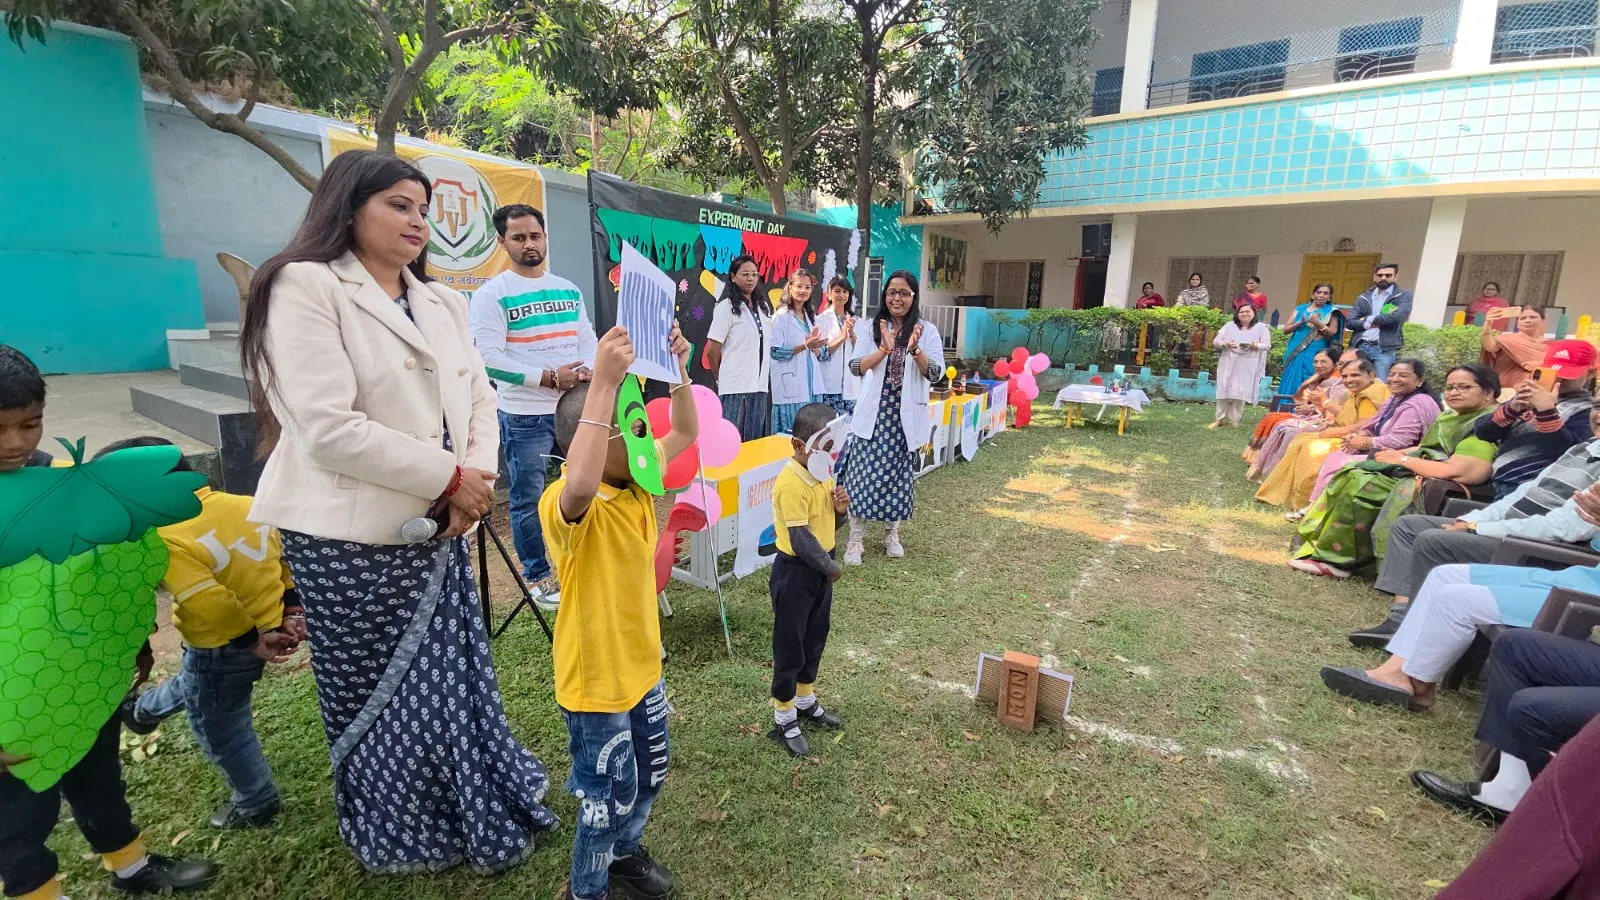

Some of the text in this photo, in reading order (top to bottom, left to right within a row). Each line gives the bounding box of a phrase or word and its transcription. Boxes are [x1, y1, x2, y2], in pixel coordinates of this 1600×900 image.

[698, 206, 786, 236] EXPERIMENT DAY
[620, 271, 678, 378] WINNER
